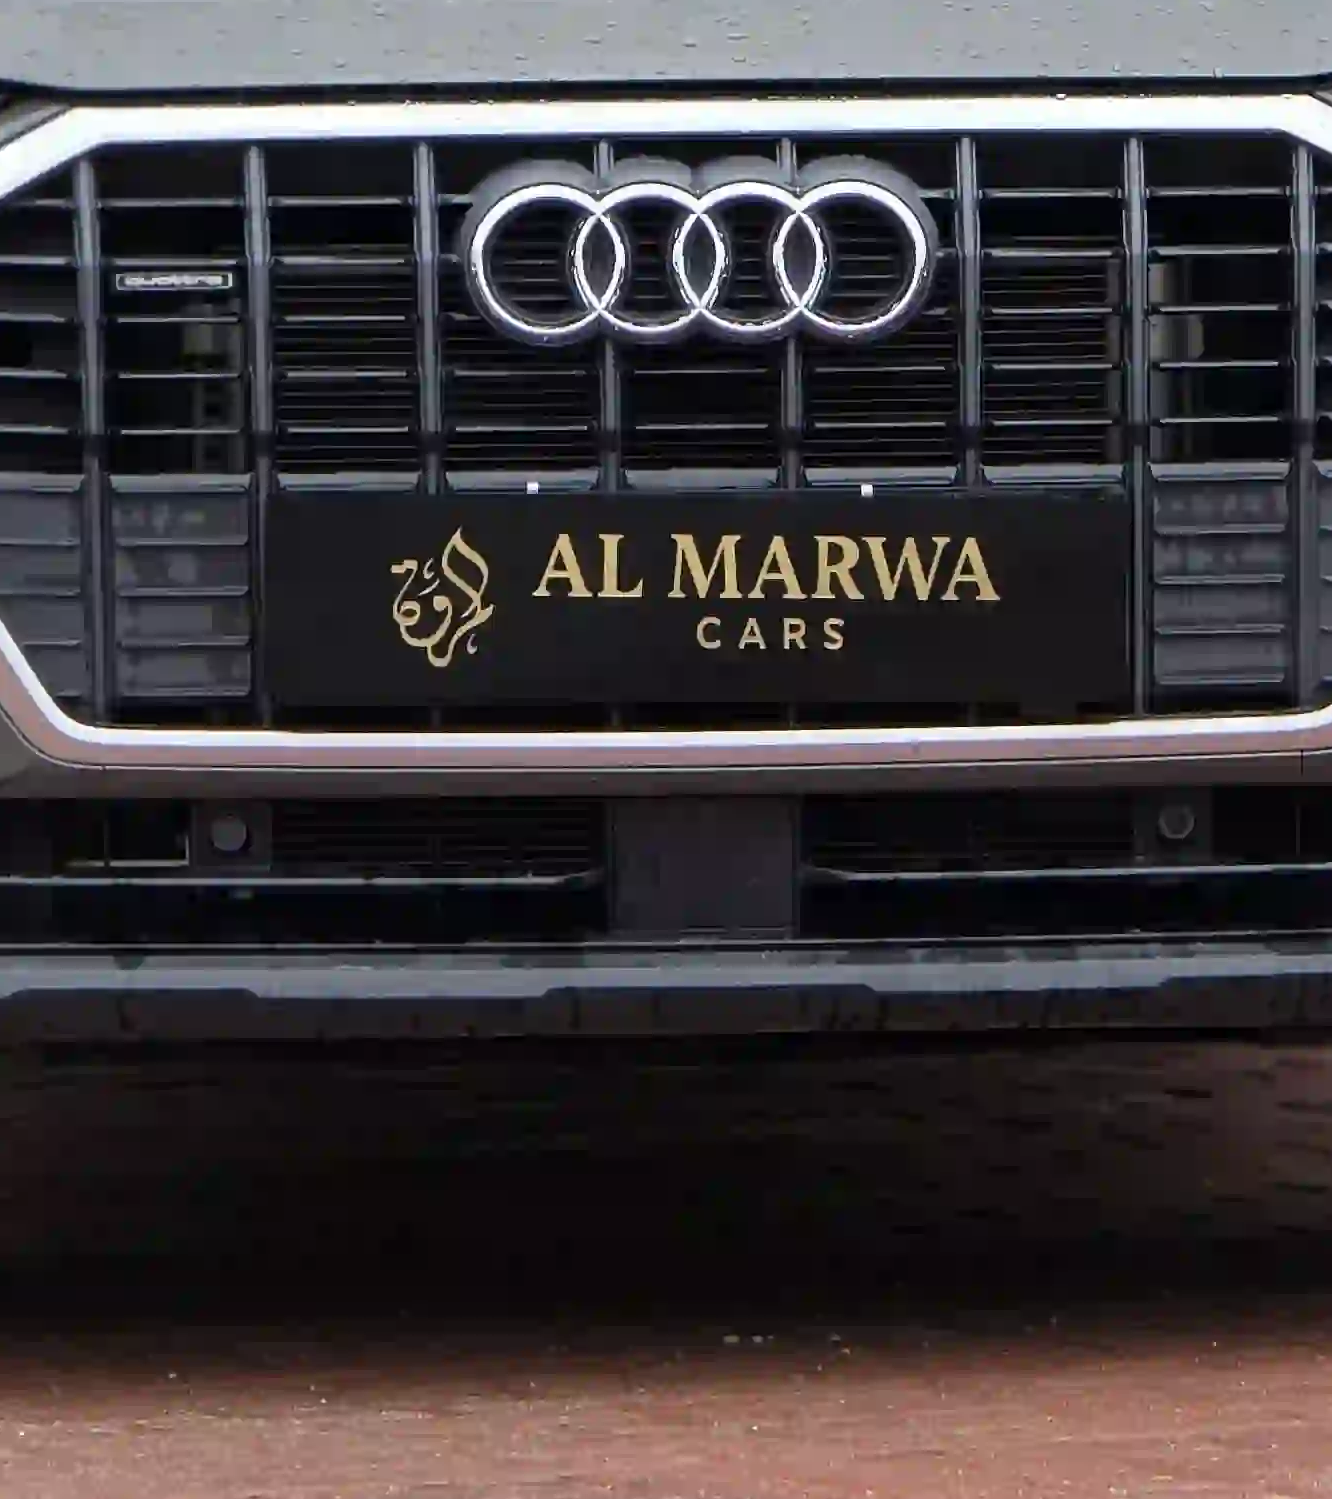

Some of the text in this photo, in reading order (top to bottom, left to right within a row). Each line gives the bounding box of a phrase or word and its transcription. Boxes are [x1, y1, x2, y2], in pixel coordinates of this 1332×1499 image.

[532, 533, 1001, 601] AL MARWA
[696, 616, 846, 651] CARS
